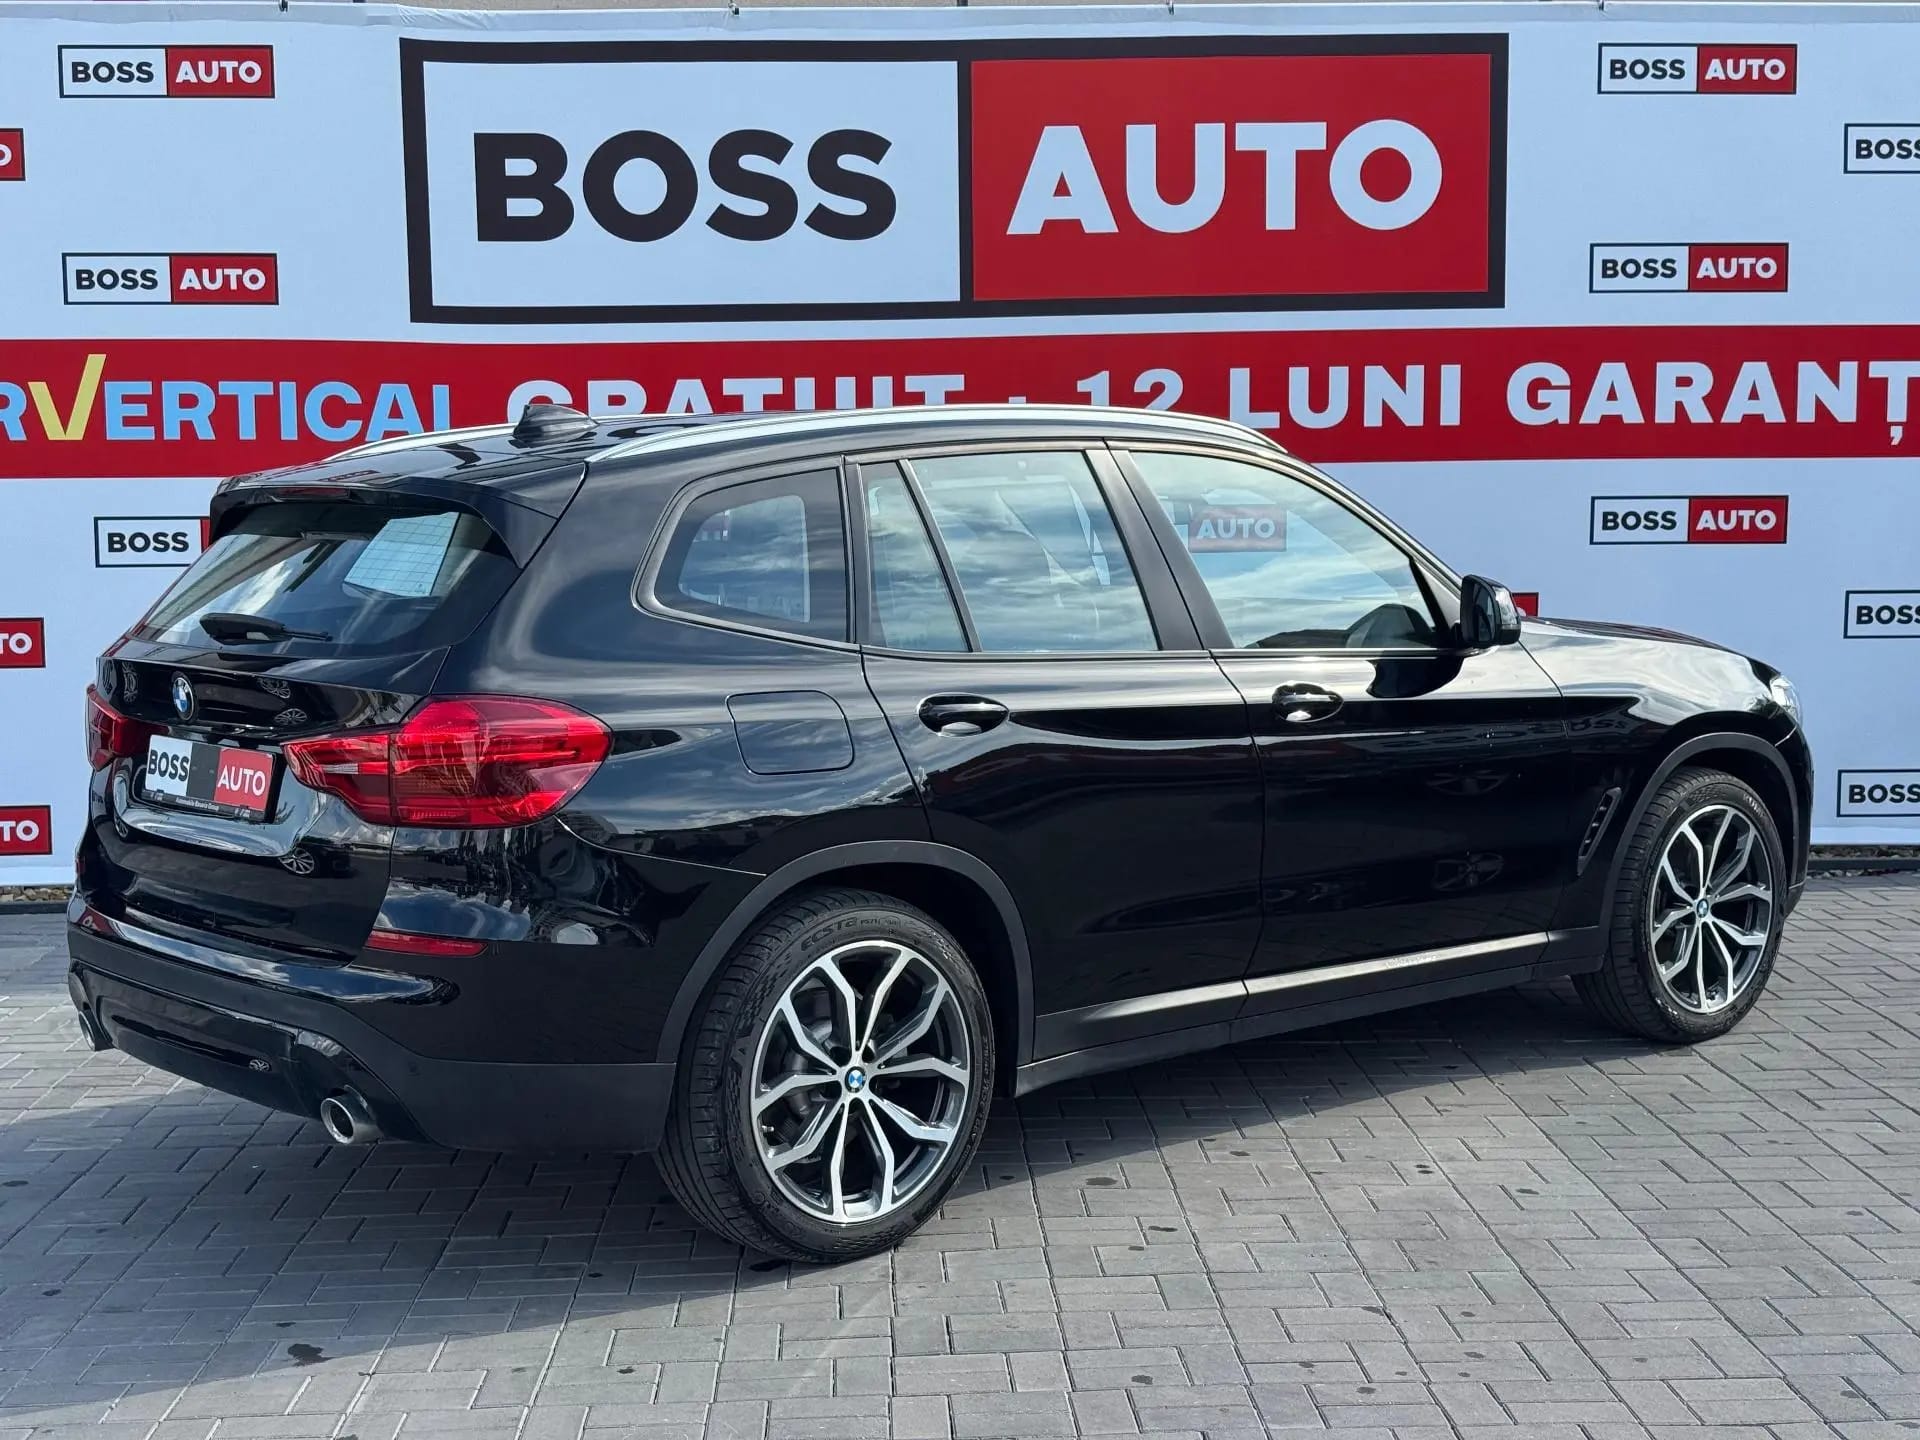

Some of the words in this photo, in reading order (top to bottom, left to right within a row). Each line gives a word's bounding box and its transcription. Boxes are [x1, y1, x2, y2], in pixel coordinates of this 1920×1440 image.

[71, 61, 154, 84] BOSS
[175, 60, 262, 84] AUTO
[1608, 58, 1686, 81] BOSS
[1704, 57, 1786, 81] AUTO
[473, 128, 897, 242] BOSS
[1006, 118, 1443, 236] AUTO
[75, 268, 159, 291] BOSS
[179, 267, 267, 291] AUTO
[1600, 257, 1677, 280] BOSS
[1696, 256, 1777, 280] AUTO
[1076, 368, 1184, 410] 12
[1229, 363, 1462, 429] LUNI
[1196, 518, 1276, 539] AUTO
[1600, 510, 1677, 532] BOSS
[1695, 509, 1777, 532] AUTO
[106, 530, 190, 554] BOSS
[148, 749, 190, 782] BOSS
[217, 764, 266, 797] AUTO
[1848, 783, 1920, 804] BOSS
